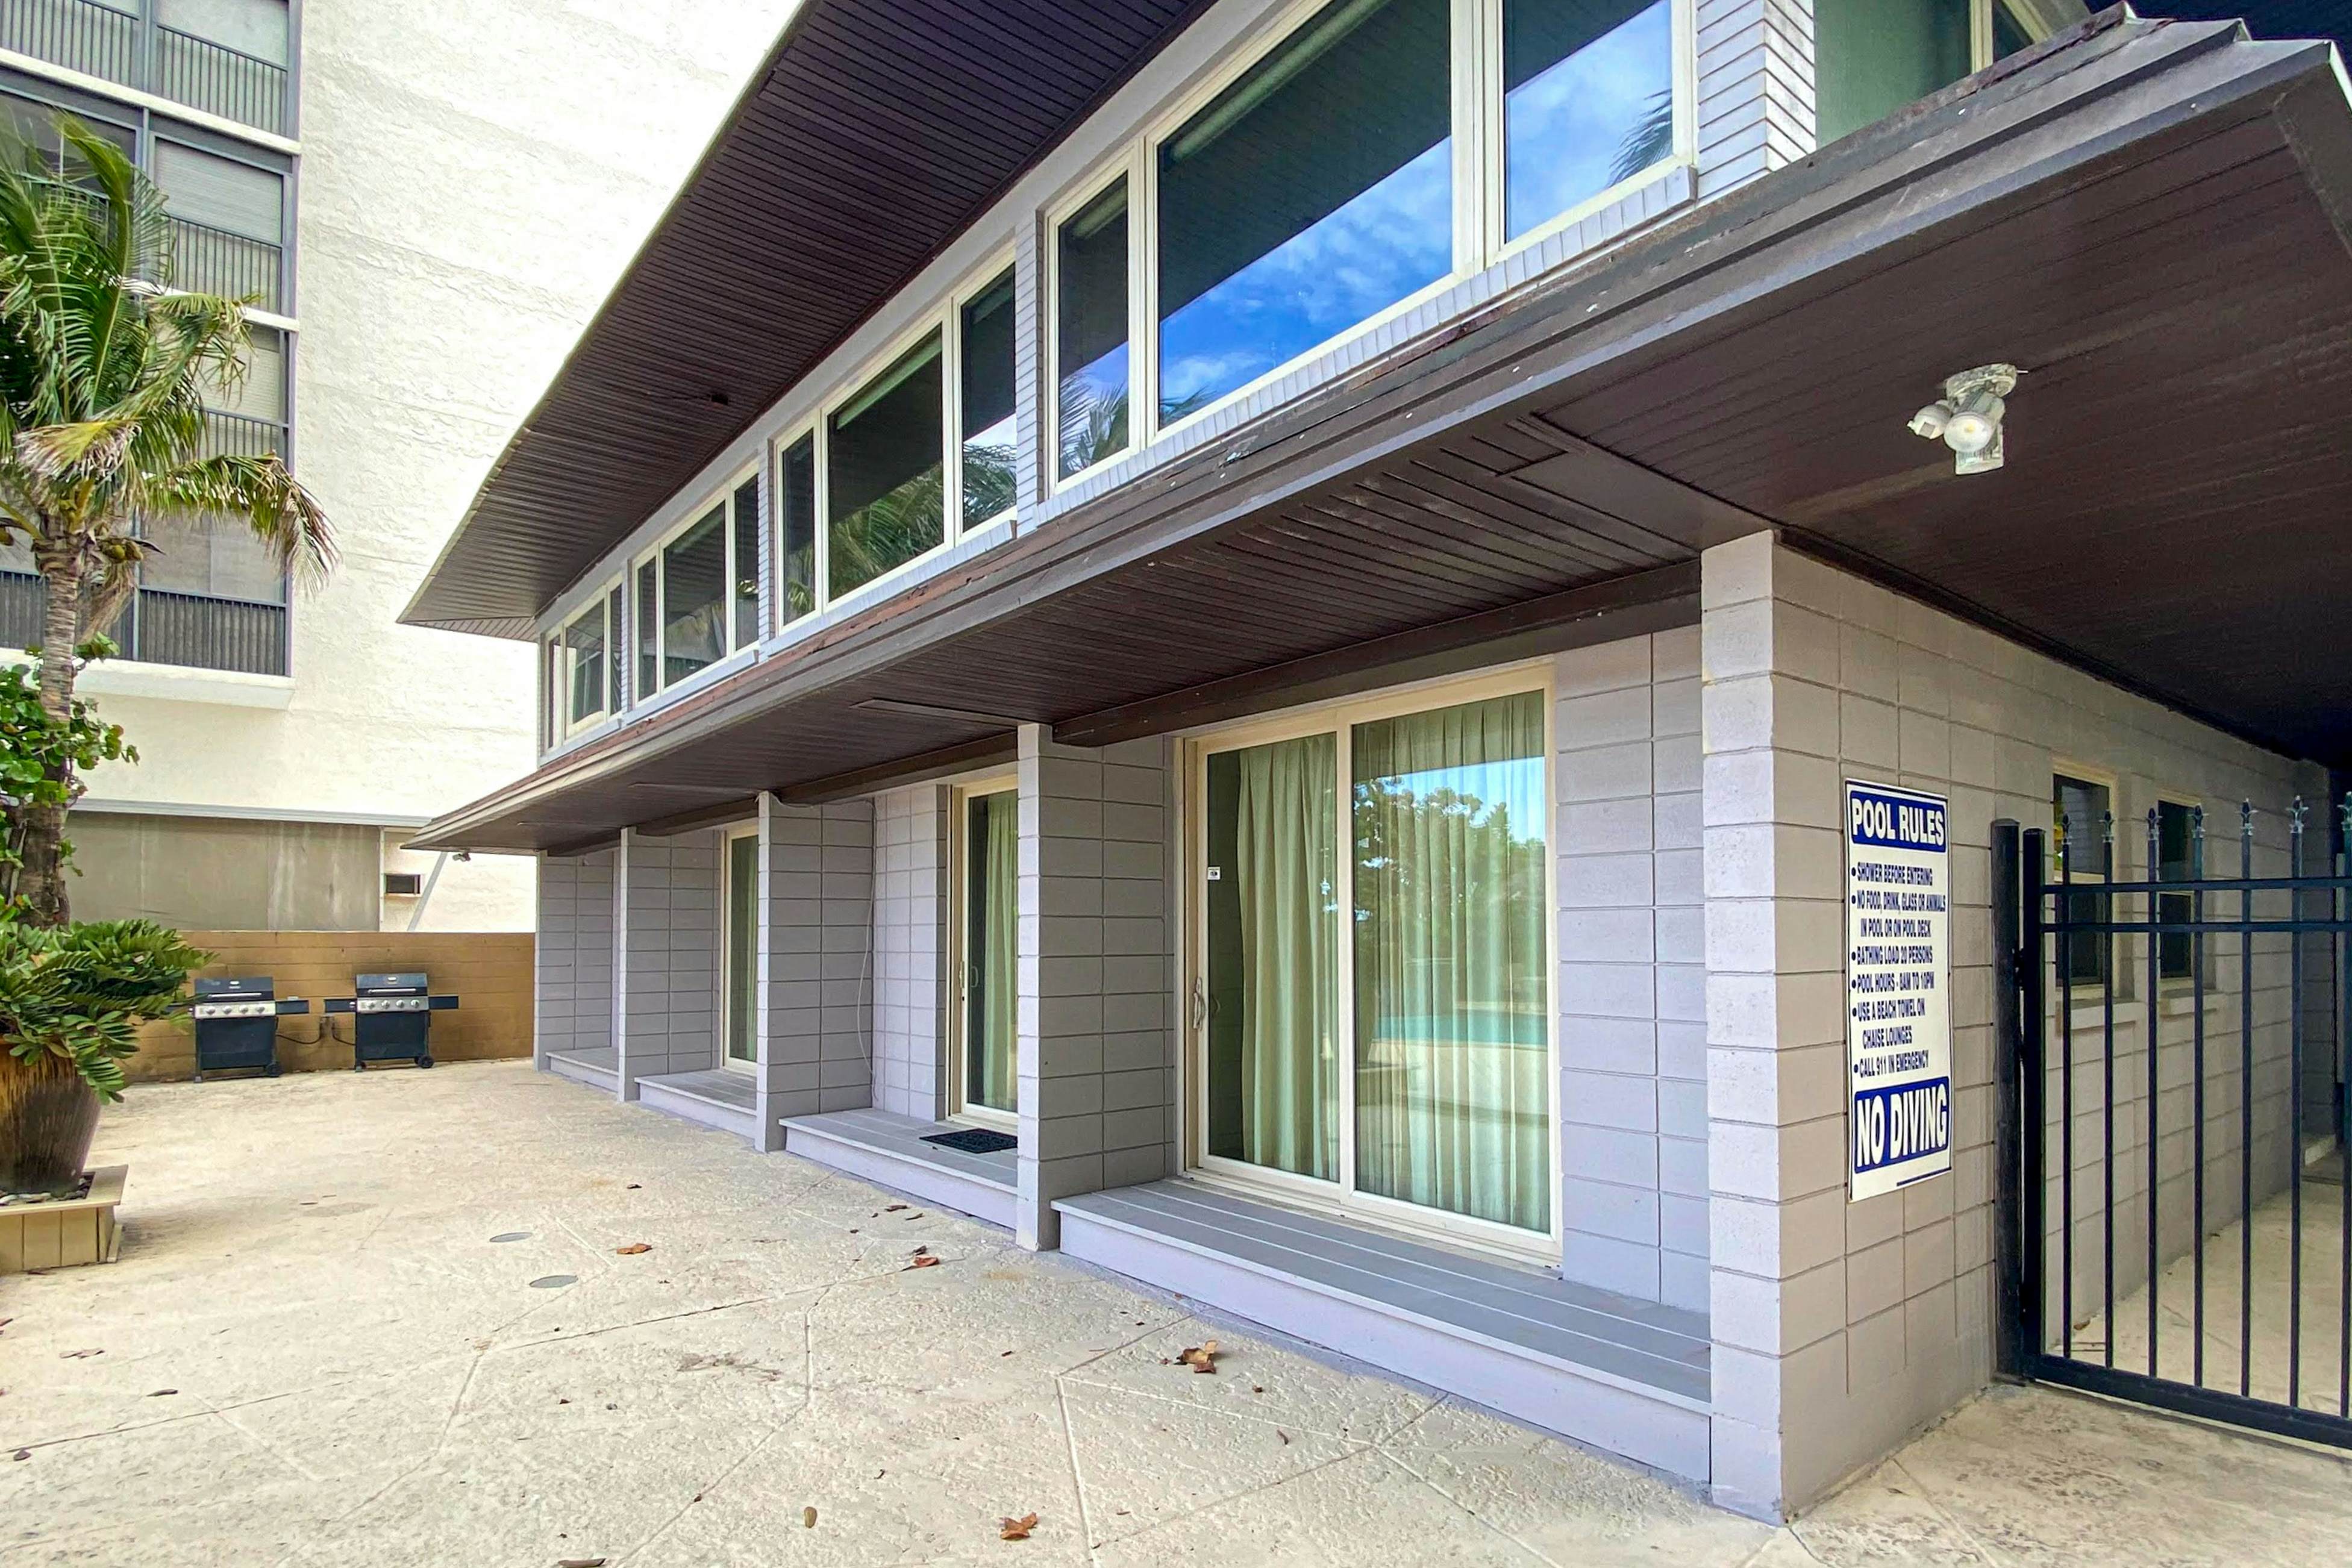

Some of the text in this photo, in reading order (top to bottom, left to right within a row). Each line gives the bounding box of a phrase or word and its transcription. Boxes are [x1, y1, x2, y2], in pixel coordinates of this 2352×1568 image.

[1851, 798, 1944, 846] POOL RULES
[1857, 862, 1933, 886] SHOWER BEFORE ENTERING
[1857, 890, 1945, 914] NO FOOD, DRINK, GLASS OR ANIMALS
[1861, 918, 1931, 937] IN POOL OR ON POOL DECK
[1857, 946, 1933, 965] BATHING LOAD 20 PERSONS
[1857, 974, 1874, 993] POOL
[1875, 973, 1895, 992] HOURS
[1912, 972, 1919, 990] TO
[1921, 972, 1934, 989] 10PM
[1857, 998, 1925, 1022] USE A BEACH TOWEL ON
[1863, 1025, 1912, 1049] CHAISE LOUNGES
[1860, 1050, 1928, 1078] CALL 911 IN EMERGENCY
[1857, 1084, 1947, 1167] NO DIVING
